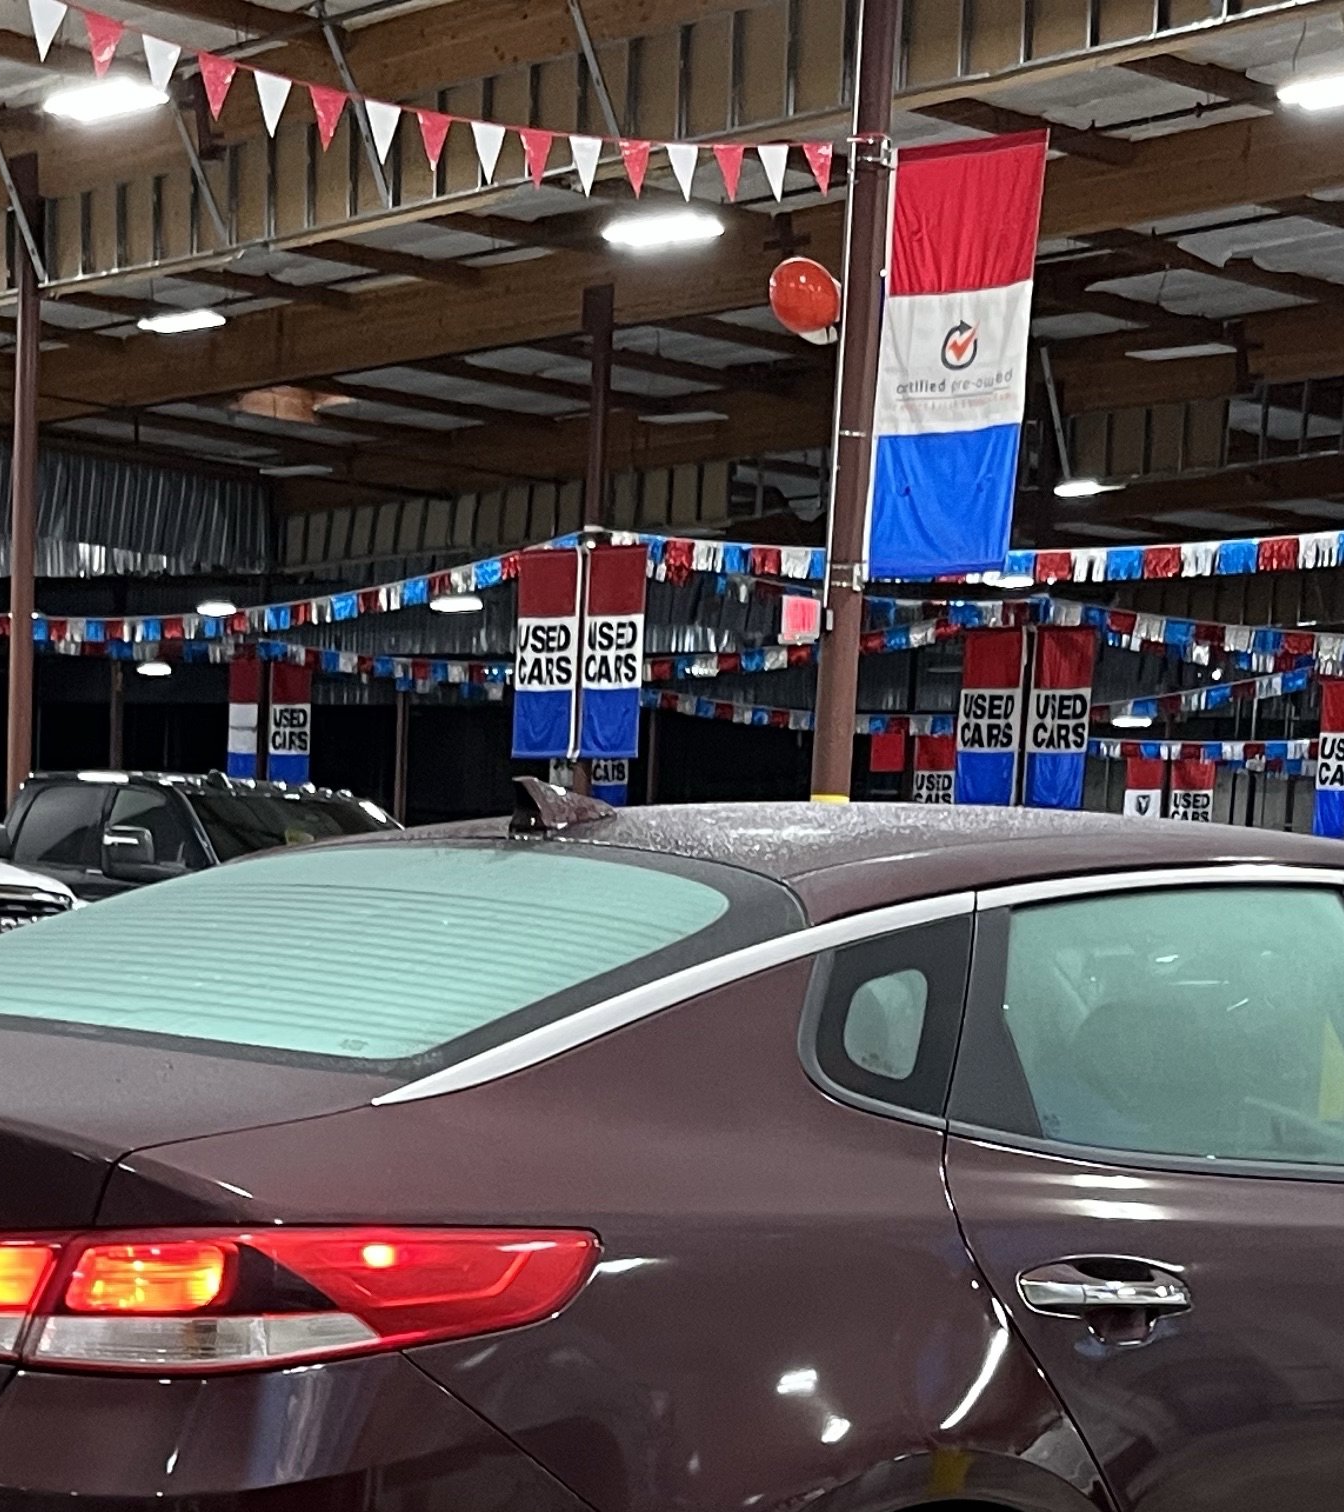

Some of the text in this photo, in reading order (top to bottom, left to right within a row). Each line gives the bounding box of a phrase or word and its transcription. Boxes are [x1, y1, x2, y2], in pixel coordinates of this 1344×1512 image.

[519, 624, 572, 653] USED
[588, 621, 638, 651] USED
[518, 656, 572, 685] CARS
[585, 653, 637, 683] CARS
[273, 707, 308, 728] USED
[963, 693, 1015, 720] USED
[960, 722, 1013, 748] CARS
[1032, 722, 1086, 749] CARS
[1173, 793, 1210, 809] USED
